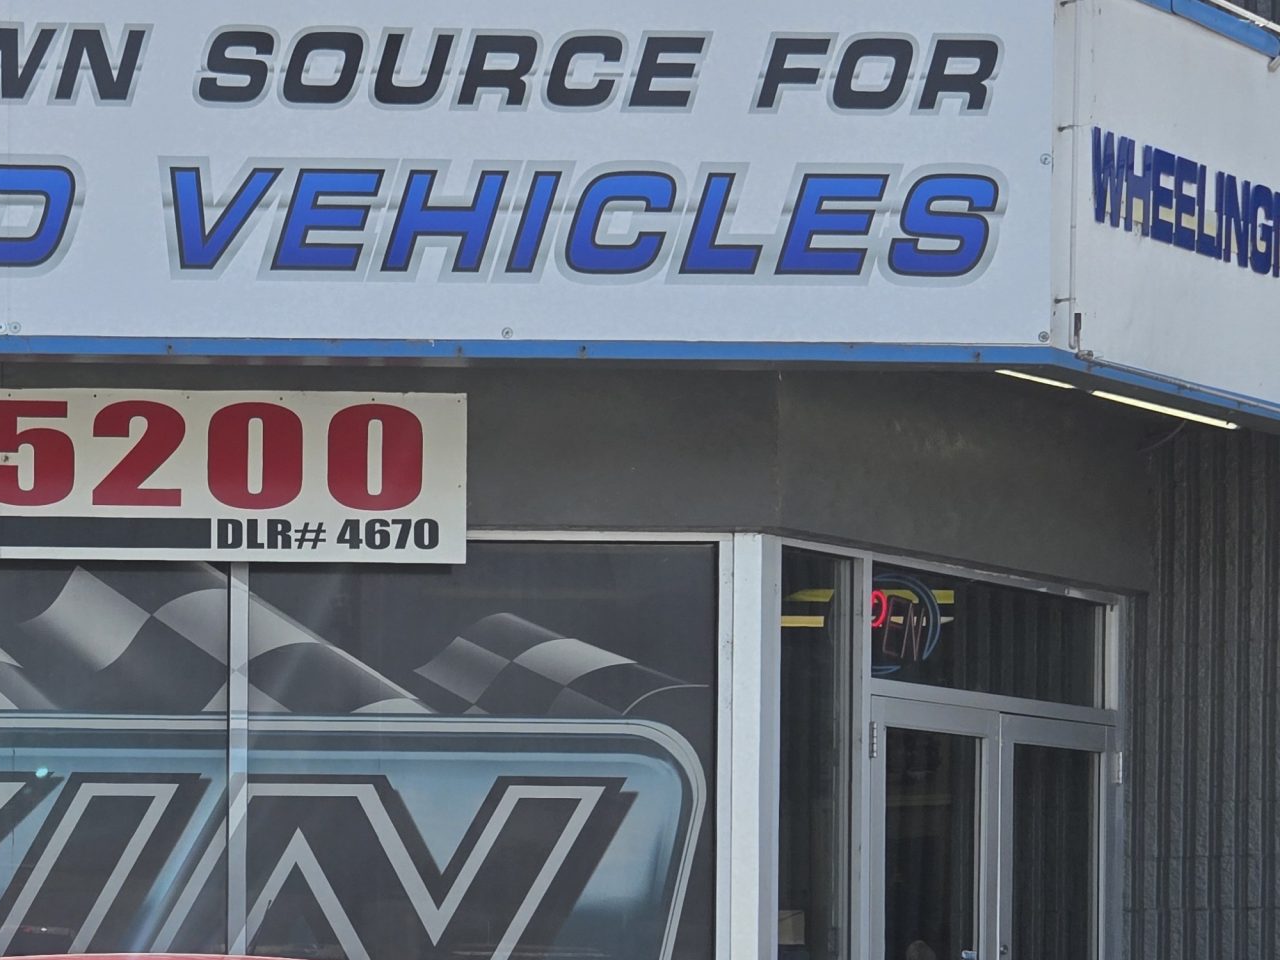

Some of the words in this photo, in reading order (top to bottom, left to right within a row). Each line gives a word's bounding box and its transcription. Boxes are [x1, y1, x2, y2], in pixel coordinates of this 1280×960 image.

[196, 30, 707, 109] SOURCE
[755, 37, 1000, 111] FOR
[167, 166, 1001, 278] VEHICLES
[216, 518, 327, 550] DLR#
[336, 518, 440, 550] 4670
